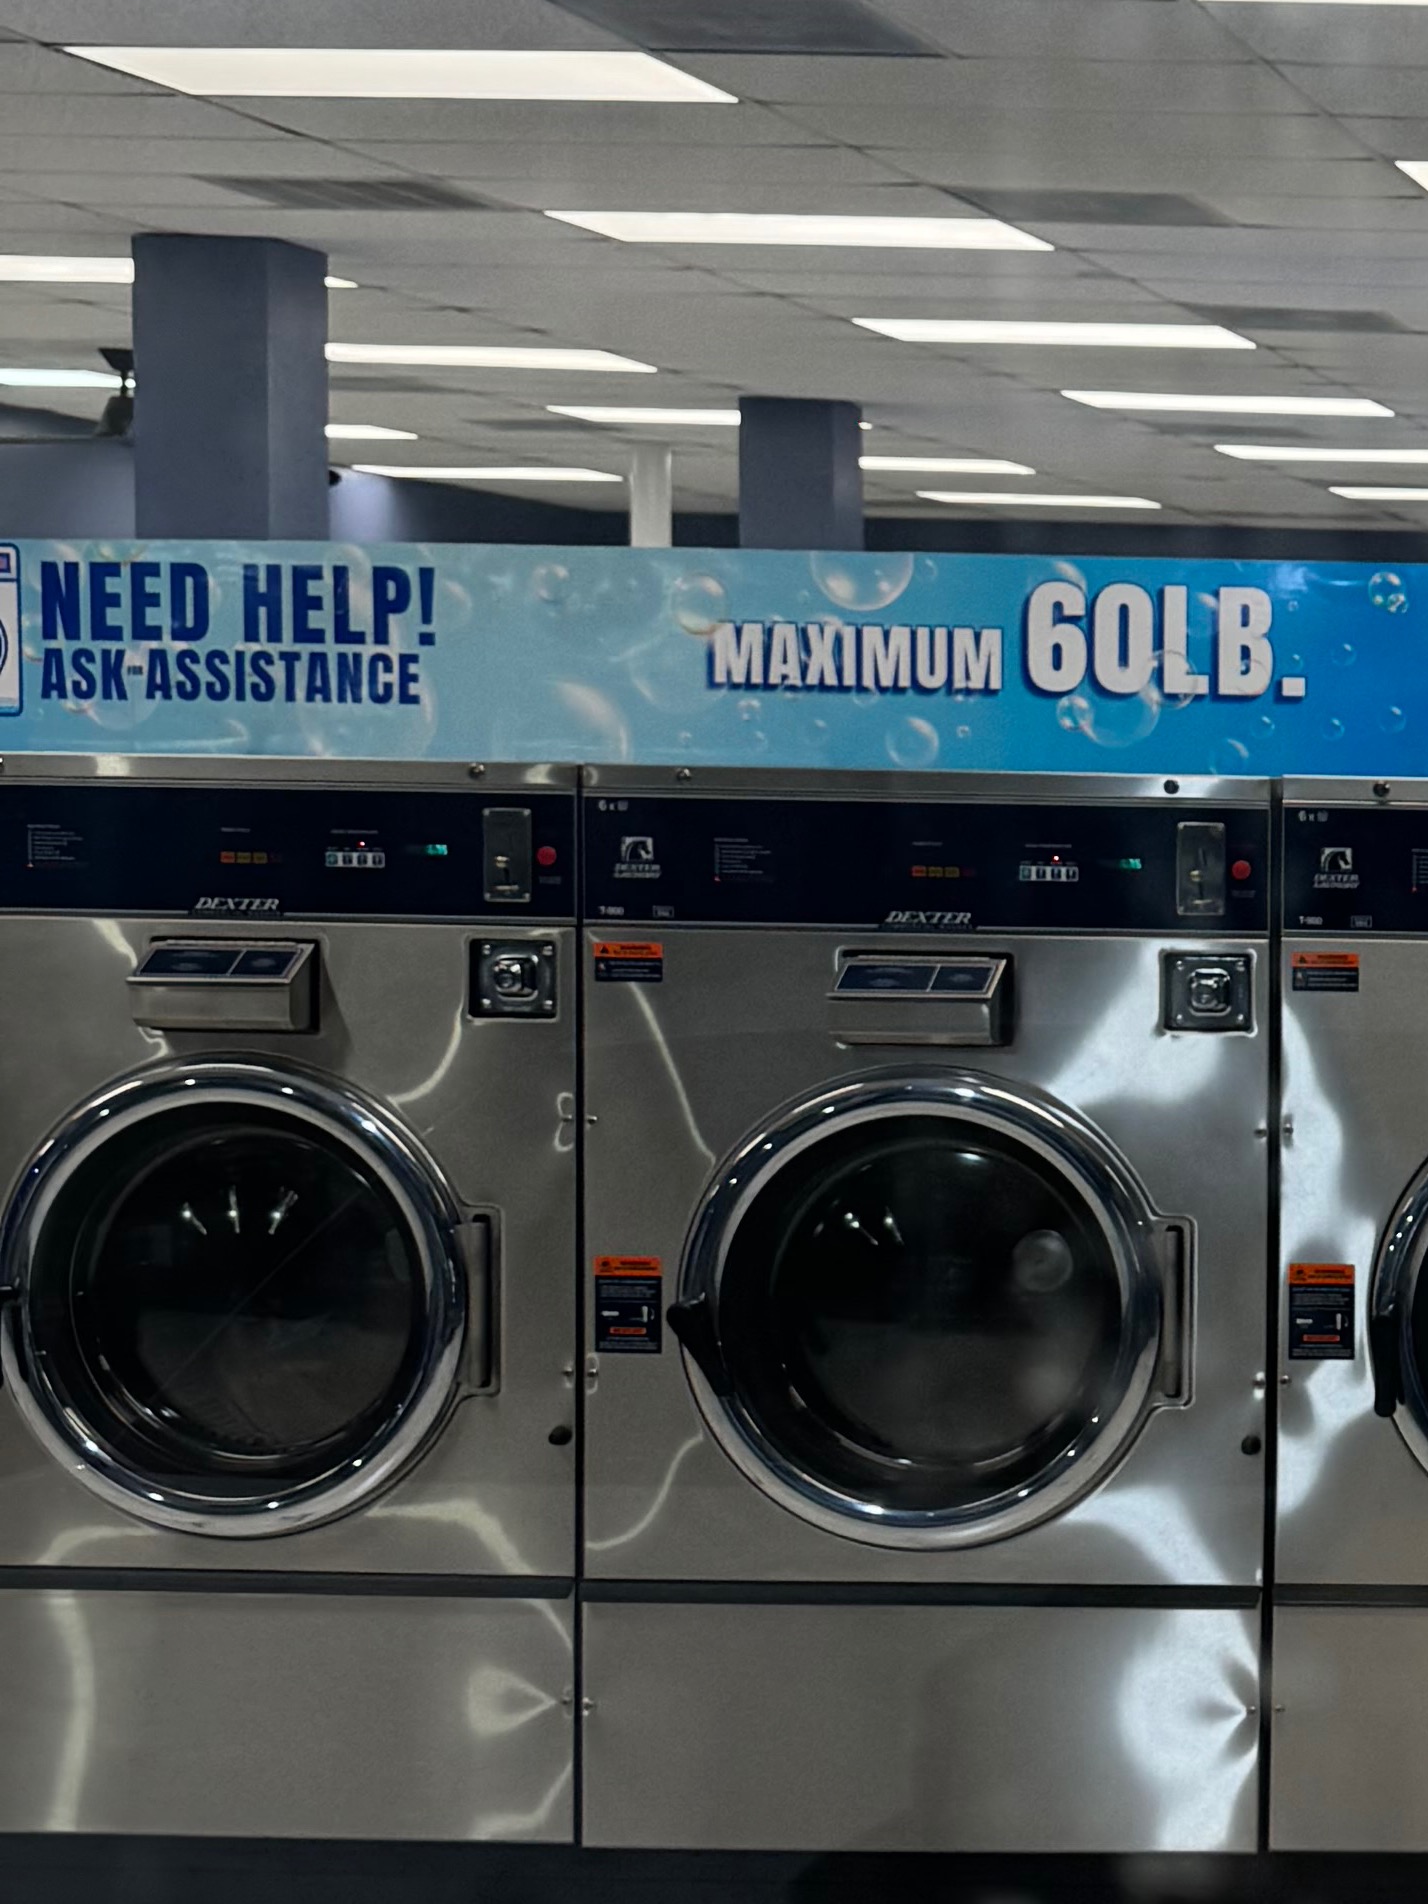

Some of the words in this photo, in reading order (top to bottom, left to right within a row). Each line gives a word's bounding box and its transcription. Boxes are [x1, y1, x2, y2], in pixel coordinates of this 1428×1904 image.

[40, 561, 209, 643] NEED
[242, 564, 436, 647] HELP!
[708, 621, 1002, 691] MAXIMUM
[1027, 581, 1306, 697] 60LB.
[40, 648, 129, 701] ASK
[145, 649, 421, 705] ASSISTANCE
[194, 897, 280, 911] DEXTER
[884, 911, 972, 925] DEXTER
